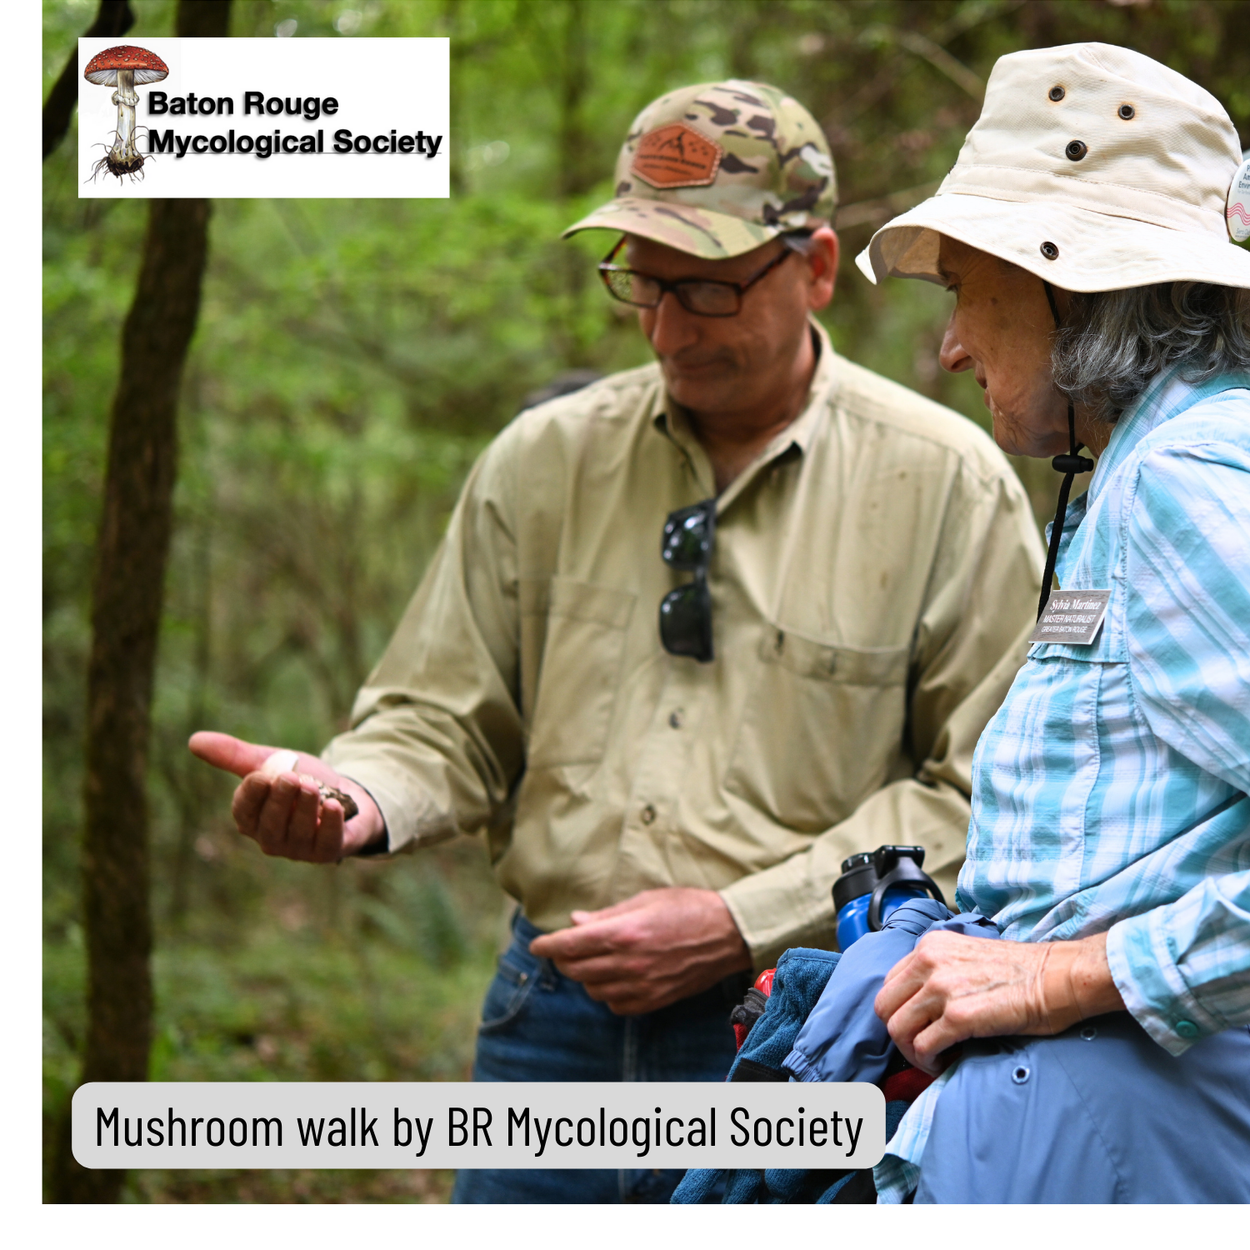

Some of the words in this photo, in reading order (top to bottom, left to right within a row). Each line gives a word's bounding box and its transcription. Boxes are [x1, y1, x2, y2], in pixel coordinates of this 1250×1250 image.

[1050, 599, 1070, 613] Sylvia
[1071, 599, 1101, 610] Martinez
[1043, 614, 1064, 623] MASTER
